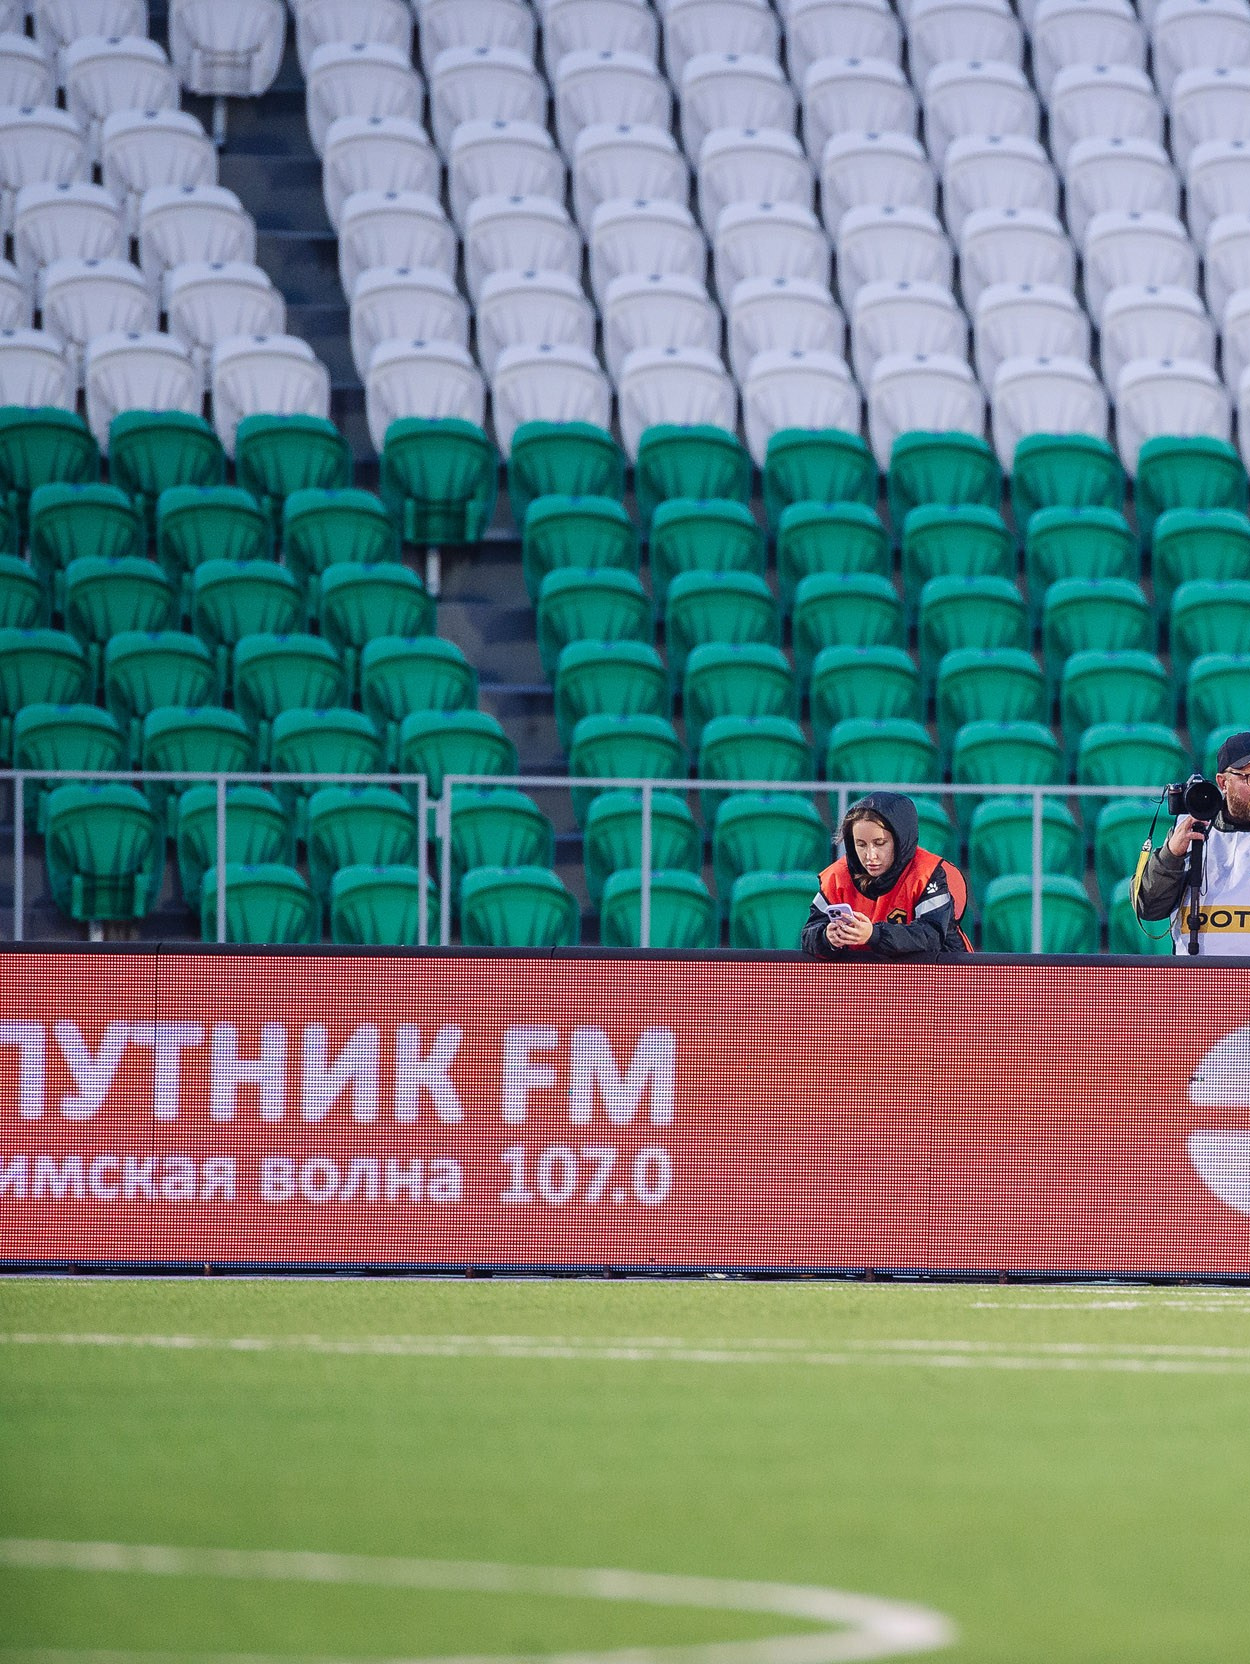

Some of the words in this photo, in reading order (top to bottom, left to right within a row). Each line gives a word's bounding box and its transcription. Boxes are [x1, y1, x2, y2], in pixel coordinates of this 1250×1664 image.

[502, 1027, 677, 1126] FM
[260, 1157, 463, 1203] волна
[500, 1143, 673, 1206] 107.0
